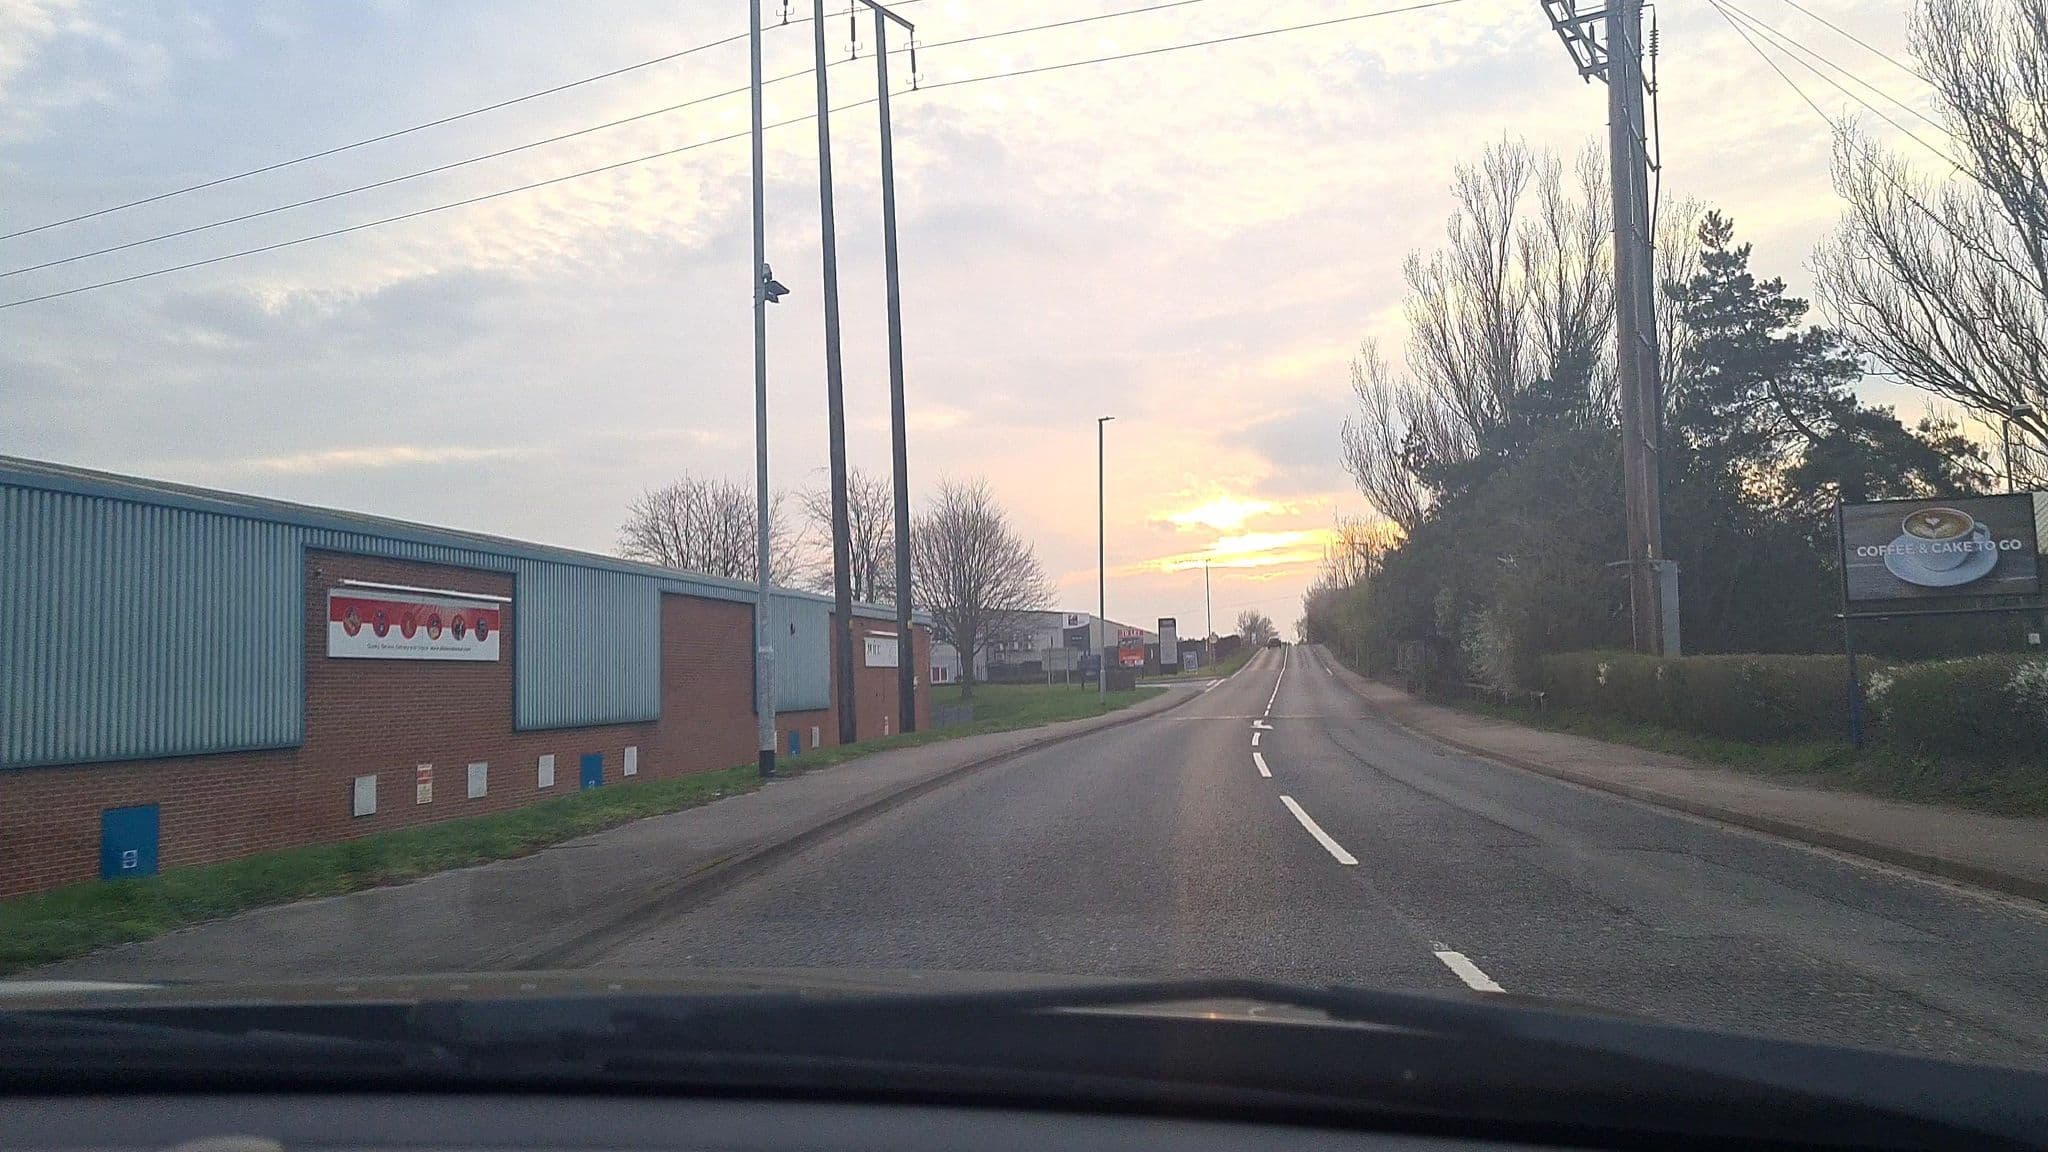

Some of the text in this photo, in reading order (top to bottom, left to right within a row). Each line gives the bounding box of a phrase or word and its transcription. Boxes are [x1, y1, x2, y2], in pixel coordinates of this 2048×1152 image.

[1856, 538, 2023, 558] COFFEE & CAKE TO GO
